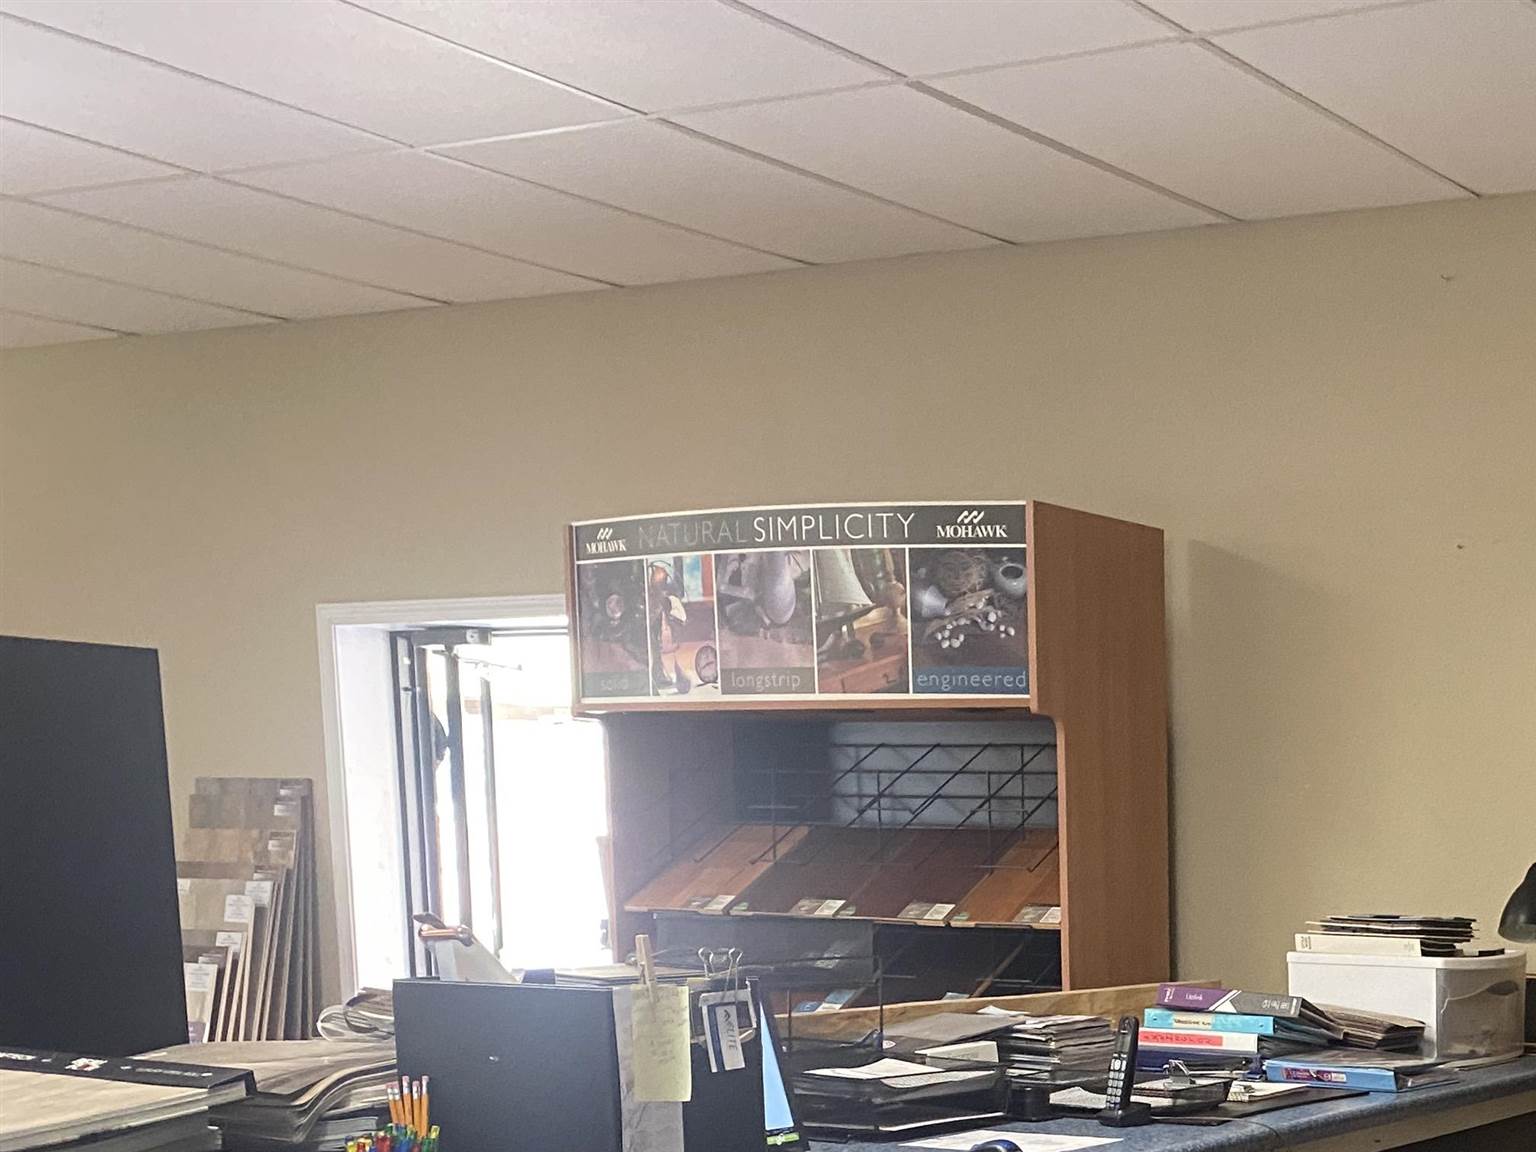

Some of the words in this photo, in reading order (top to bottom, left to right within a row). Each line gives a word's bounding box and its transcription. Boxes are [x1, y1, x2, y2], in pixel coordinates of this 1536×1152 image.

[639, 519, 749, 549] NATURAL
[753, 513, 915, 542] SIMPLICITY
[936, 525, 1007, 538] MOHAWK
[586, 539, 627, 554] MOHAWK
[731, 670, 800, 691] longstrip
[917, 671, 1027, 691] engineered
